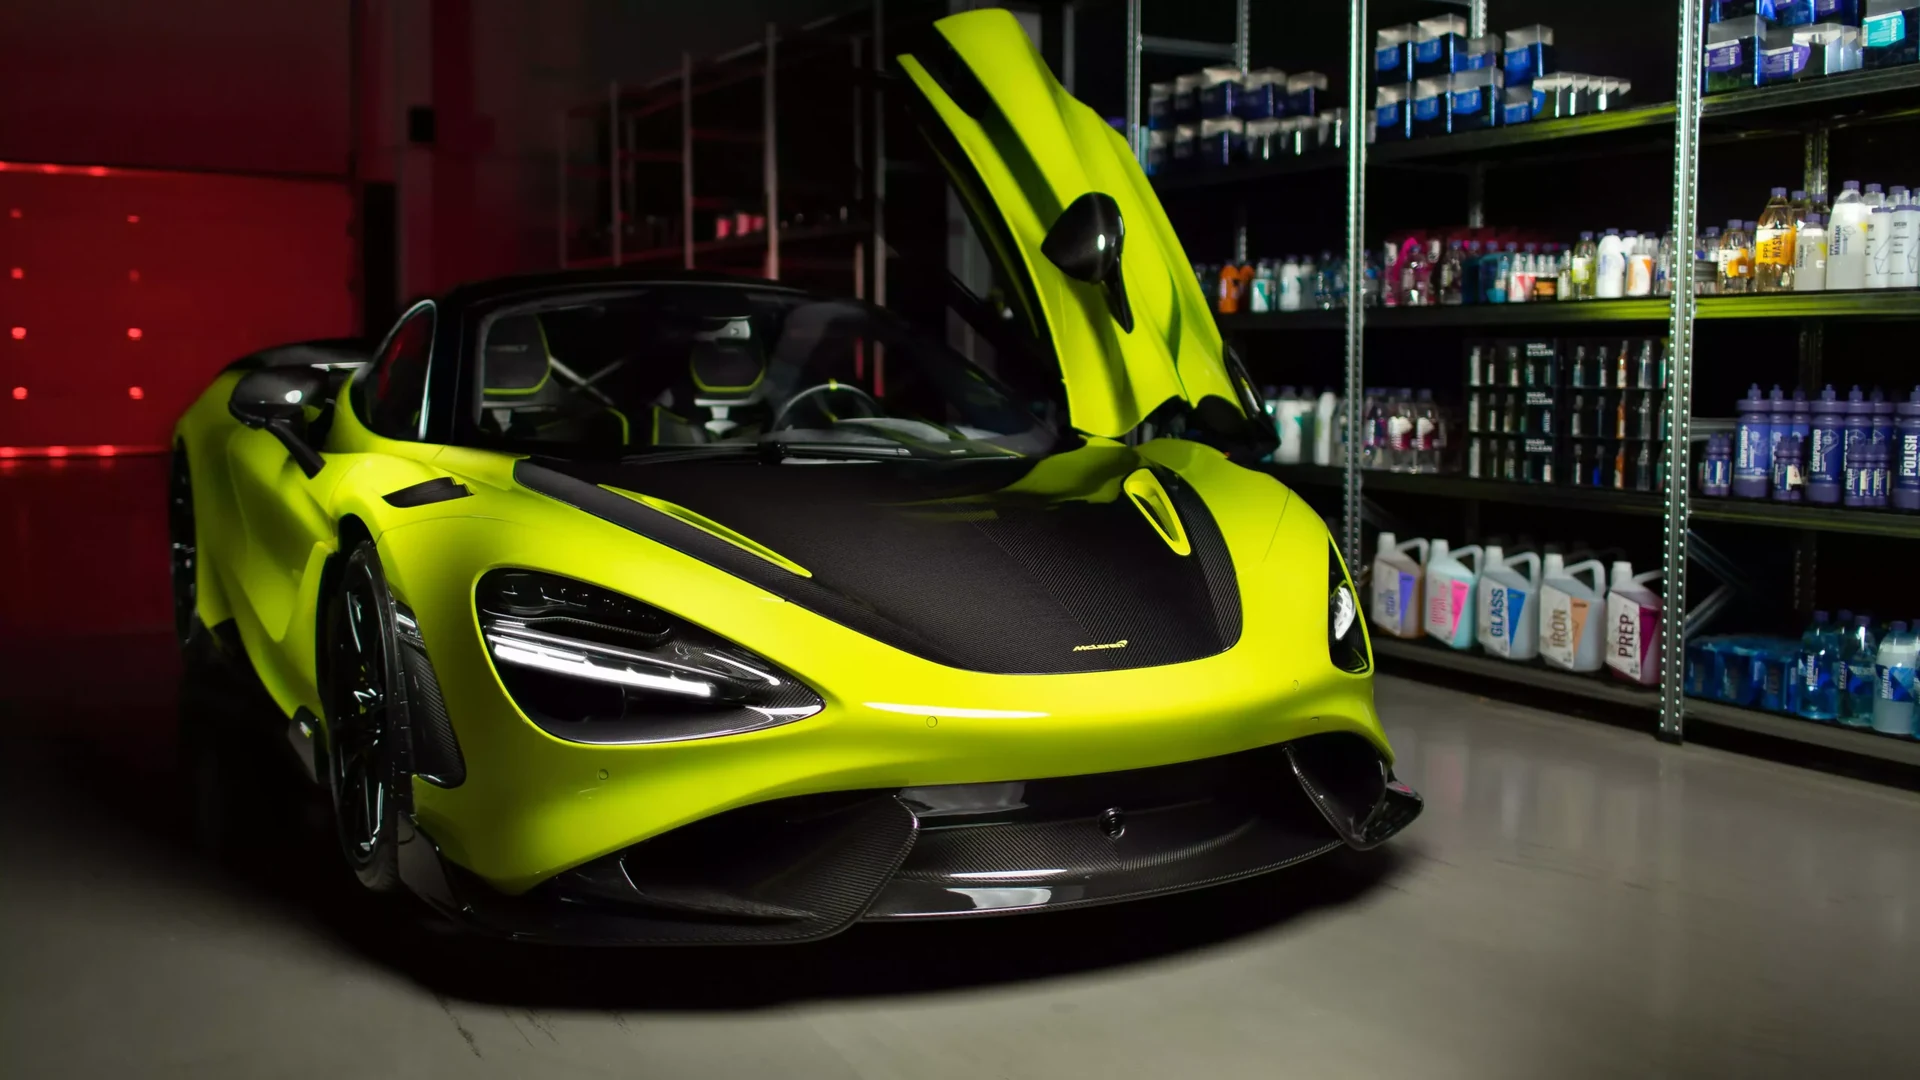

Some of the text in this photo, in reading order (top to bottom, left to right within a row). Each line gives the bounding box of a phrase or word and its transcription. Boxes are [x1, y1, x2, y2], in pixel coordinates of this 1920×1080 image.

[1772, 234, 1782, 258] WASH
[1812, 429, 1822, 472] COMPOUND
[1903, 434, 1919, 477] POLISH
[1490, 587, 1504, 638] GLASS
[1550, 608, 1567, 648] IRON
[1072, 641, 1127, 651] McLaren
[1618, 614, 1635, 658] PREP
